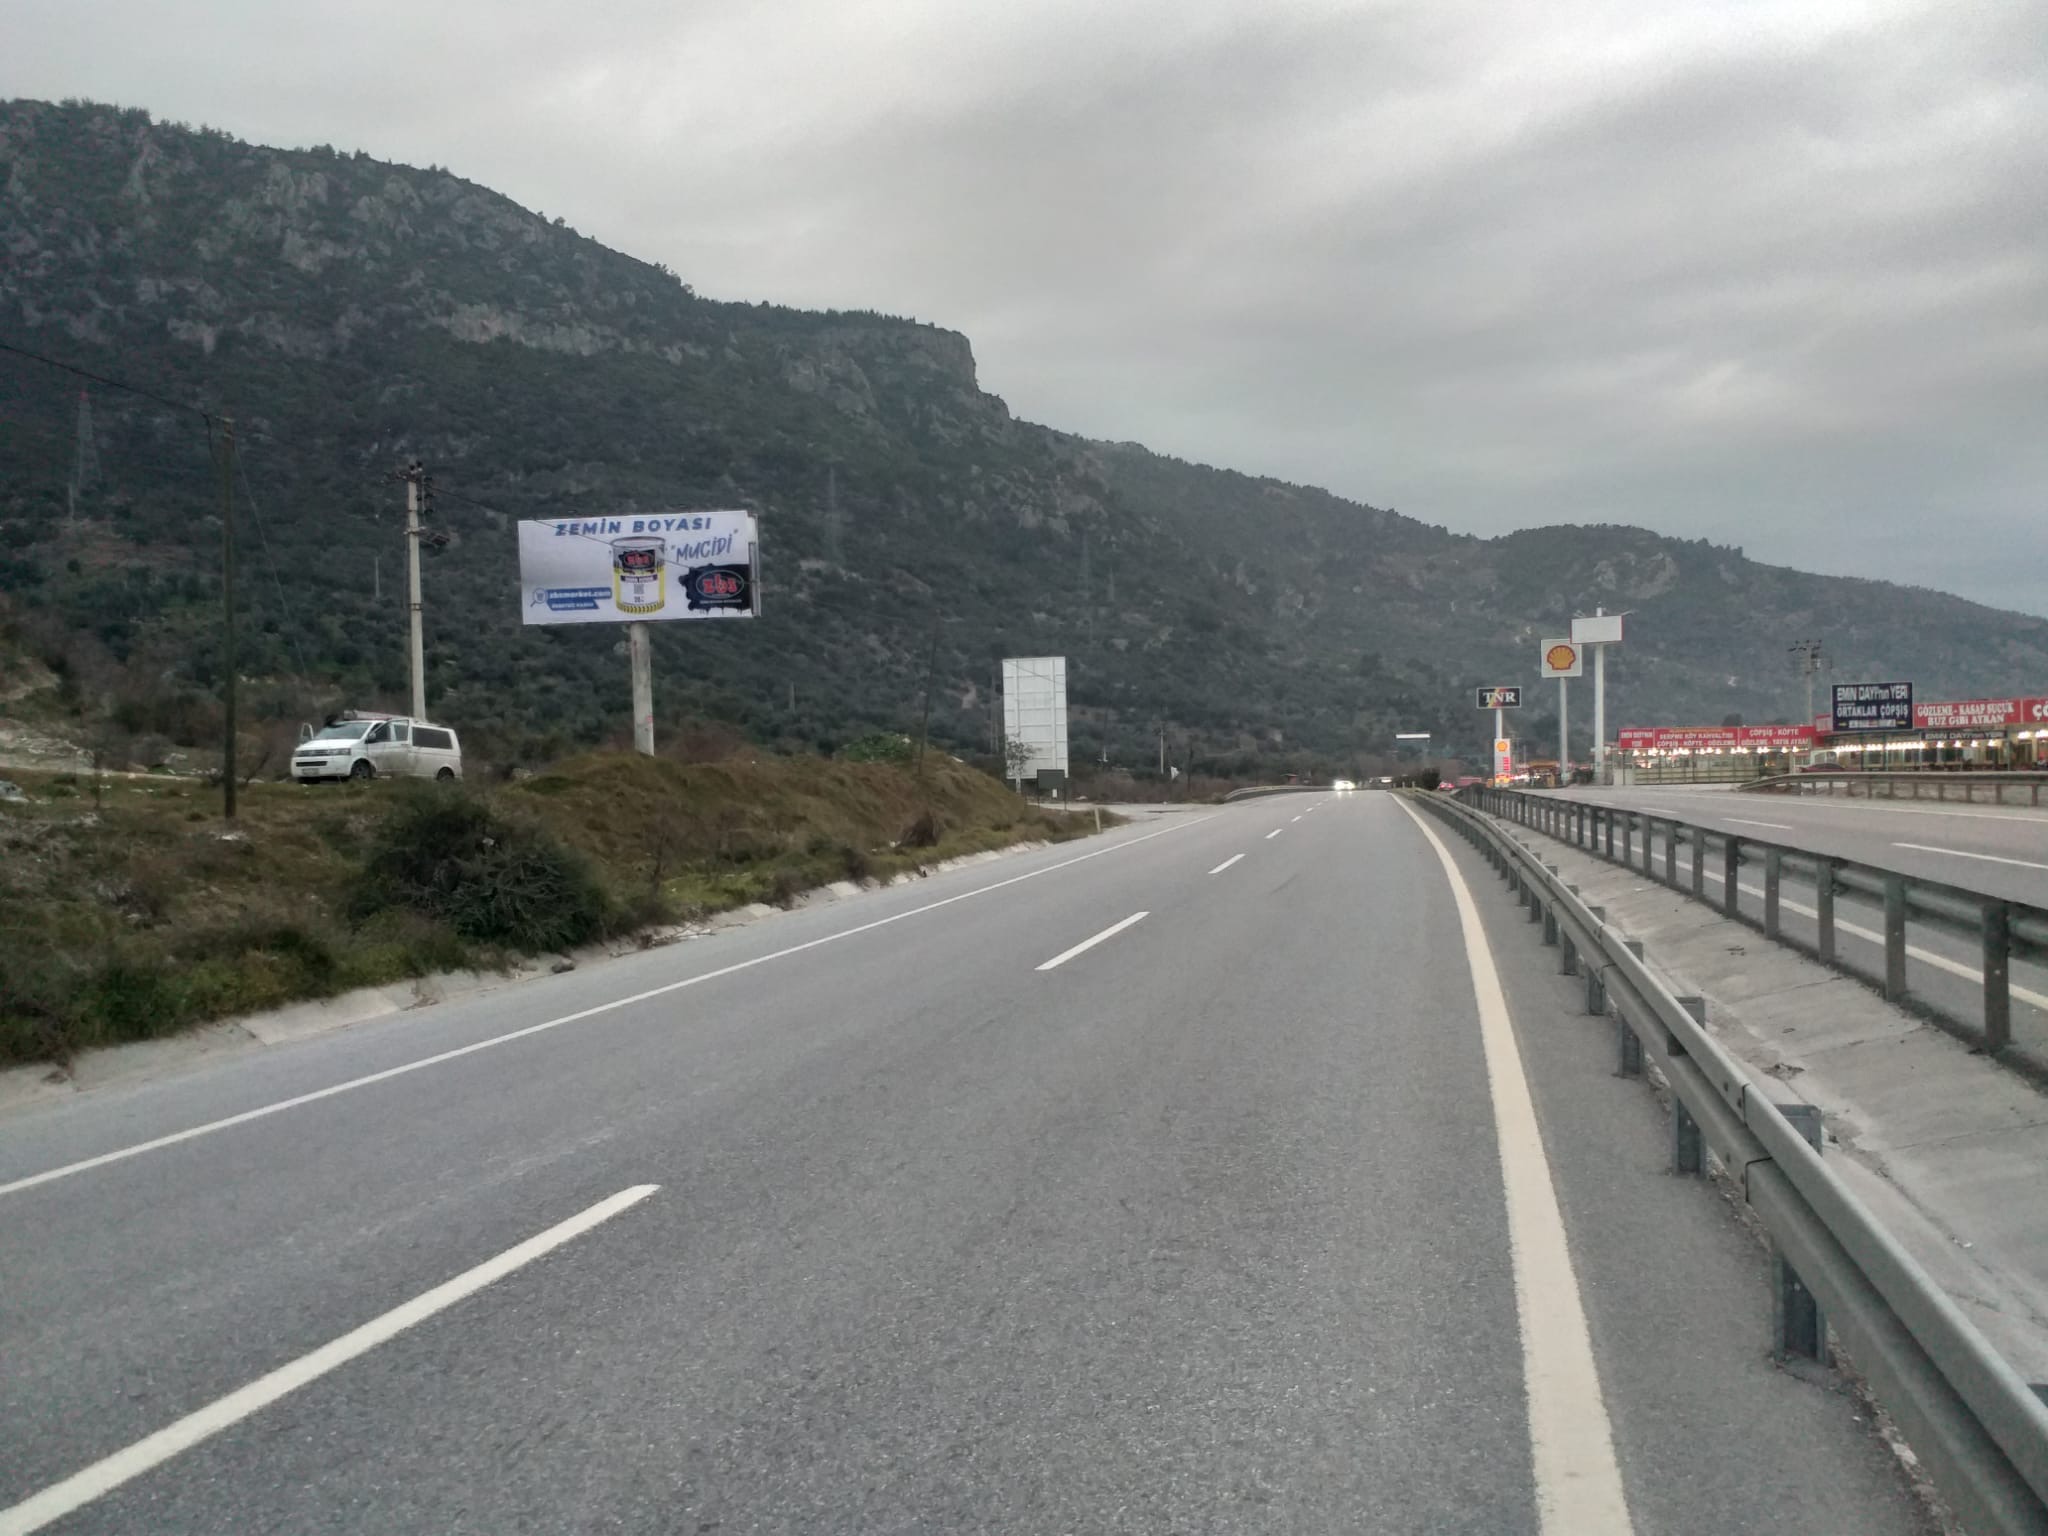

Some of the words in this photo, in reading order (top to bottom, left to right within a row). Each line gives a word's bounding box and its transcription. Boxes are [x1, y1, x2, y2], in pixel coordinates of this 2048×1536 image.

[555, 518, 621, 536] ZEMİN
[632, 517, 712, 533] BOYASI
[1483, 691, 1516, 703] TNR
[1837, 705, 1878, 718] ORTAKLAR
[1917, 704, 1953, 717] GÖZLEME
[1928, 715, 1947, 726] BUZ
[1971, 713, 2005, 725] AYRAN
